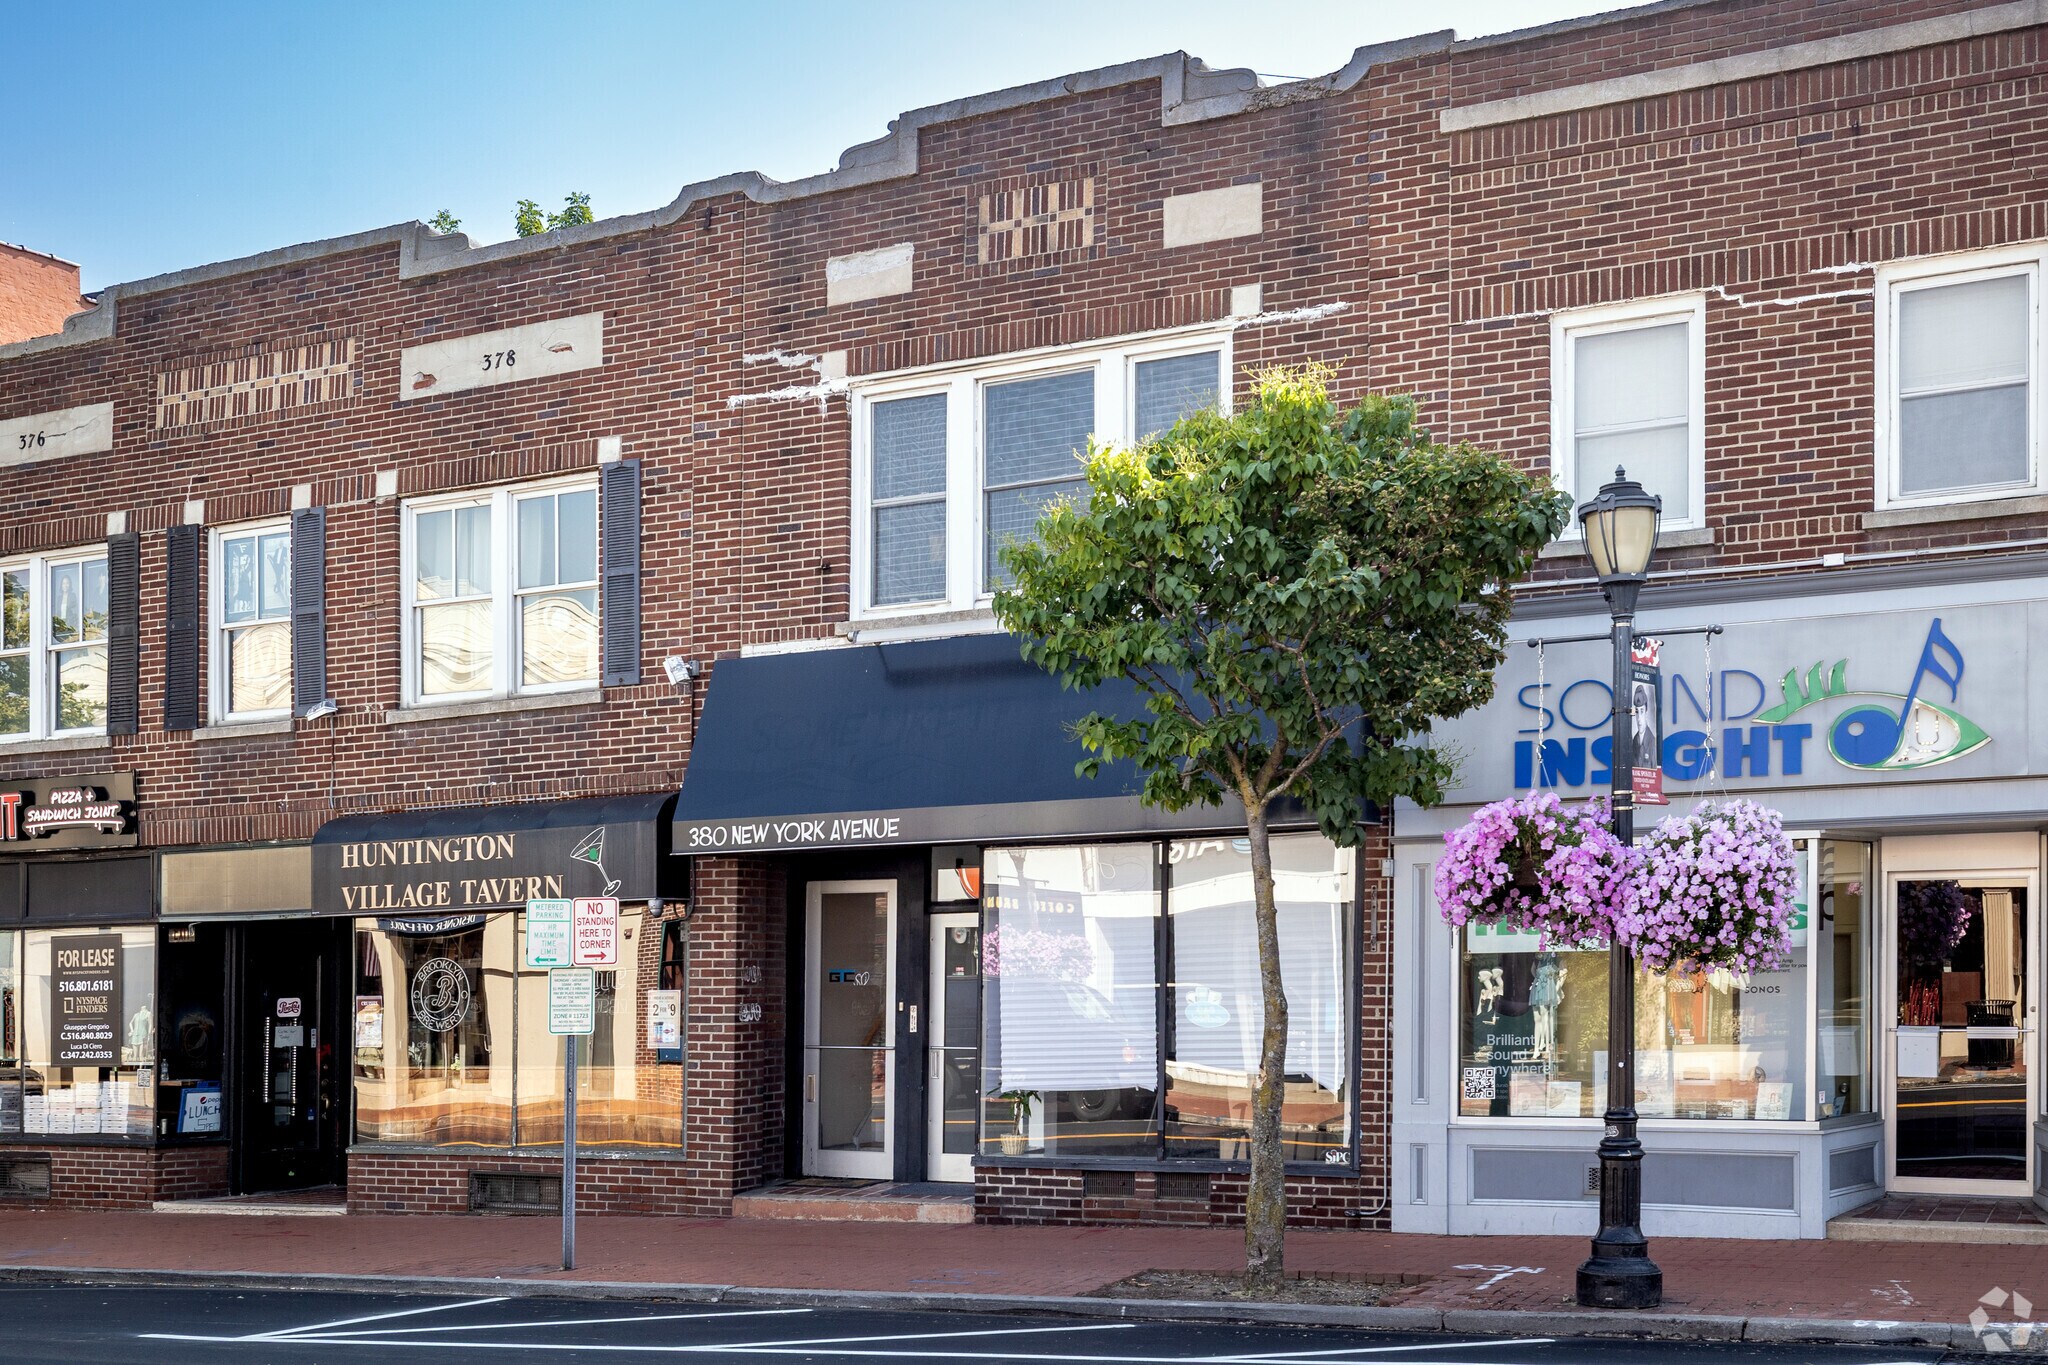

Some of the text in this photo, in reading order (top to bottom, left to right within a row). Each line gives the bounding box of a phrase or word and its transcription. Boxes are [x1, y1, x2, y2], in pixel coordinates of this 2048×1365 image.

[482, 349, 516, 371] 378
[19, 430, 45, 450] 376
[1518, 669, 1765, 733] SOND
[1514, 723, 1812, 788] INSGHT
[51, 790, 82, 804] PIZZA
[27, 805, 119, 822] SANDWICH JOINT
[688, 817, 900, 847] 380 NEW YORK AVENUE
[341, 833, 516, 869] HUNTINGTON
[341, 874, 564, 911] VILLAGE TAVERN
[535, 903, 564, 911] METERED
[587, 902, 604, 915] NO
[547, 923, 557, 931] HR
[576, 916, 614, 926] STANDING
[579, 928, 612, 938] HERE TO
[580, 939, 611, 949] CORNER
[57, 948, 115, 968] FOR LEASE
[418, 960, 464, 981] BROOKLYN
[59, 980, 113, 992] 516.801.6181
[1744, 985, 1780, 994] SONOS
[76, 996, 108, 1005] NYSPACE
[76, 1005, 108, 1014] FINDERS
[652, 1003, 659, 1017] 2
[418, 1010, 462, 1030] BREWERY
[63, 1023, 110, 1032] Giuseppe Gregorio
[60, 1031, 113, 1040] C.516.840.8029
[1486, 1033, 1536, 1046] Brilliant
[60, 1051, 113, 1059] C.347.242.0353
[1487, 1049, 1528, 1061] sound
[188, 1104, 220, 1119] LUNCH
